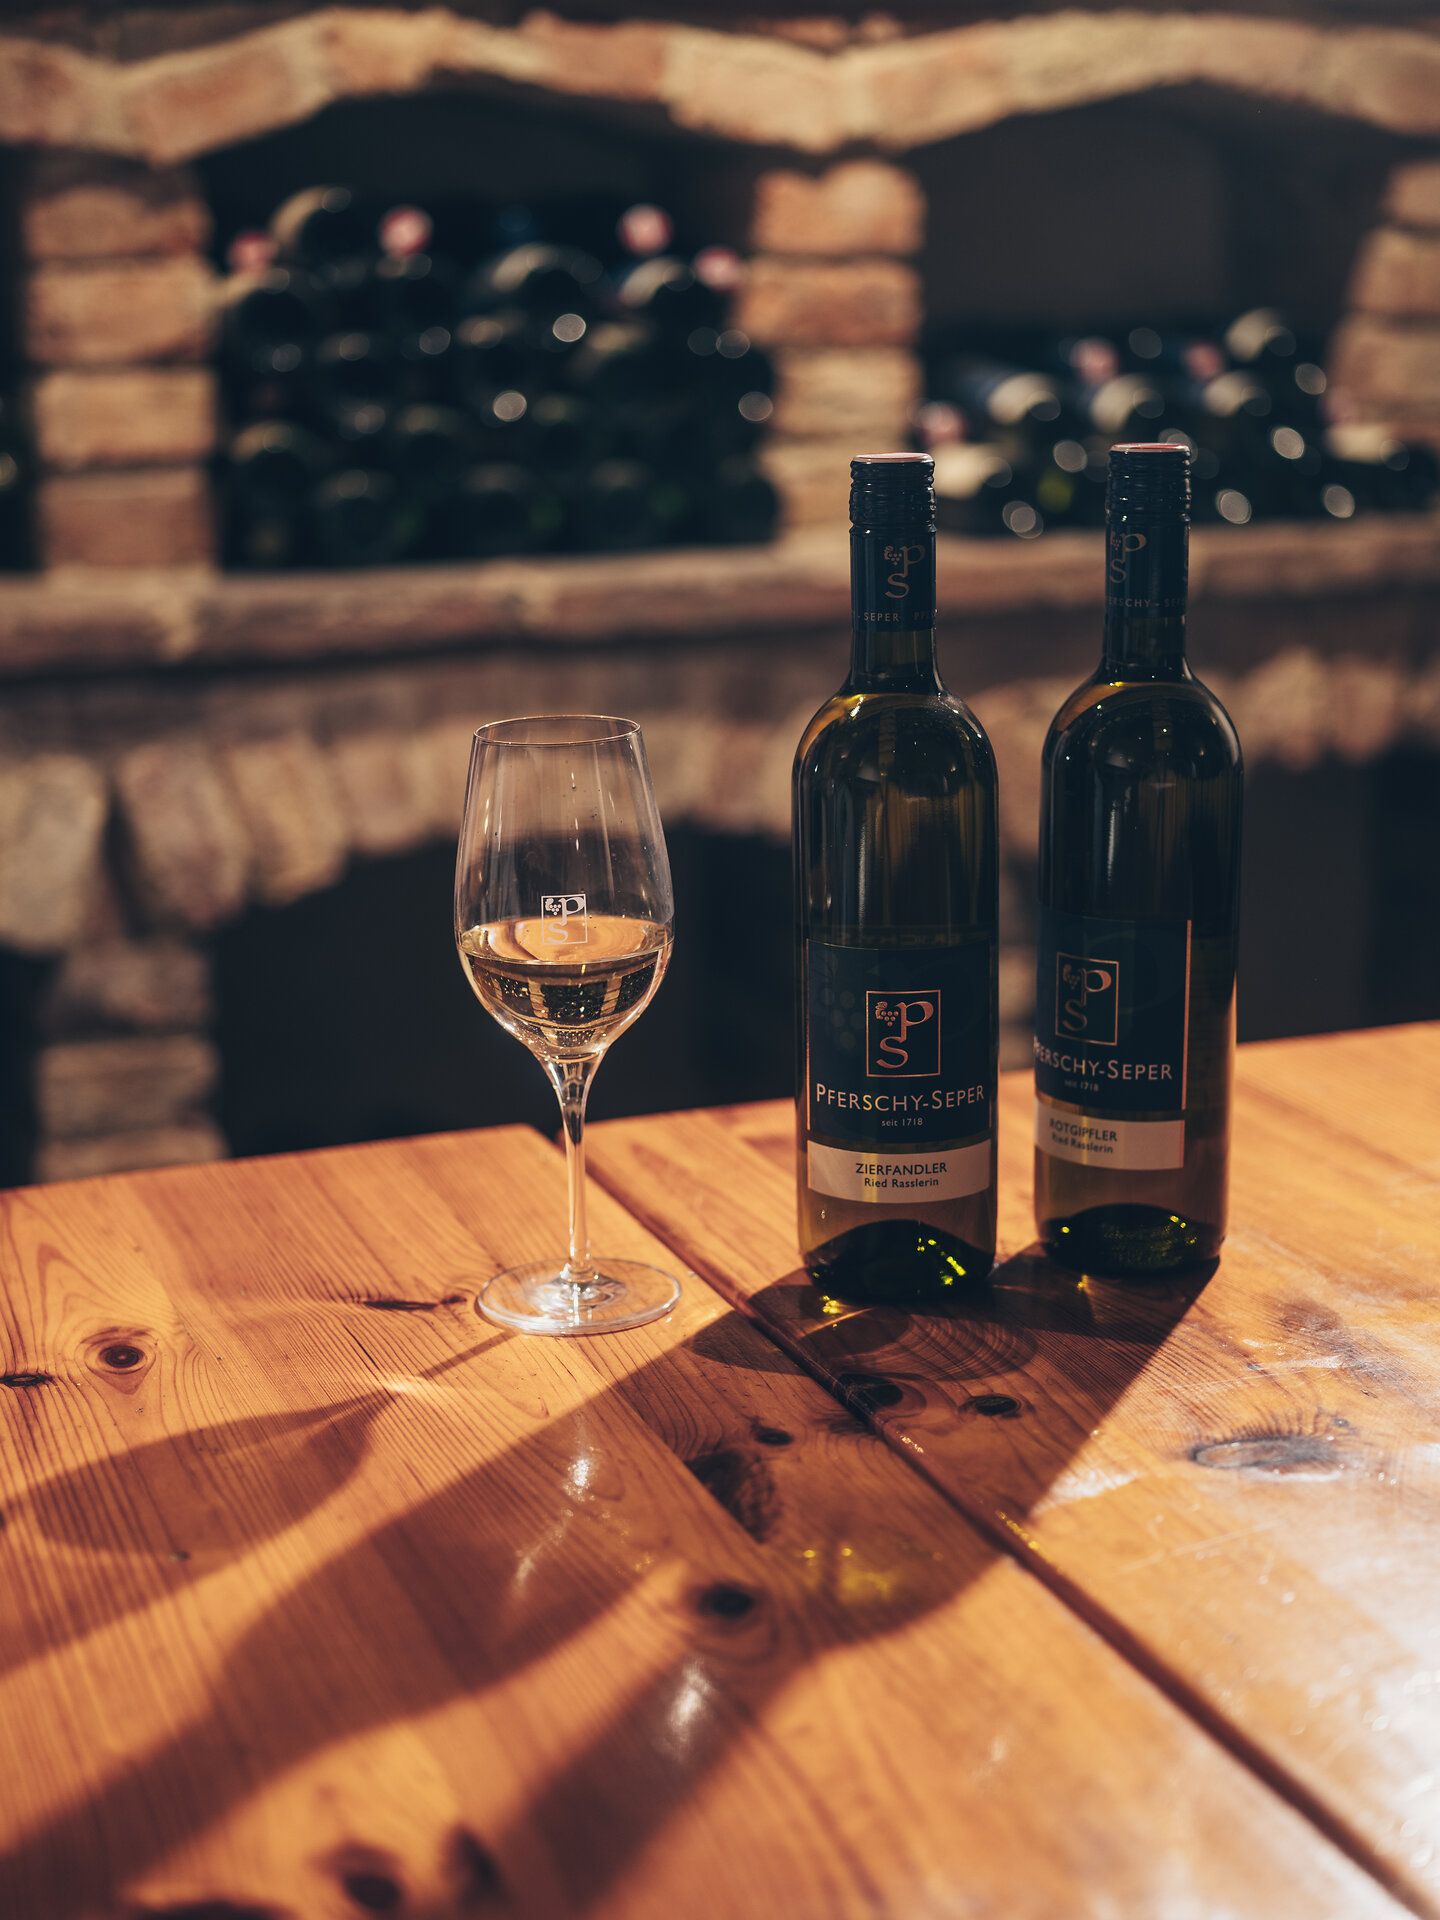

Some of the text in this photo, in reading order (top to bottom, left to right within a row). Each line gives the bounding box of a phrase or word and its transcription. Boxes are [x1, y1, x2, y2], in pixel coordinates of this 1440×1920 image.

[863, 612, 900, 622] SEPER
[881, 1117, 923, 1127] seit 1718
[855, 1162, 948, 1176] ZIERFANDLER
[864, 1177, 939, 1188] Ried Rasslerin
